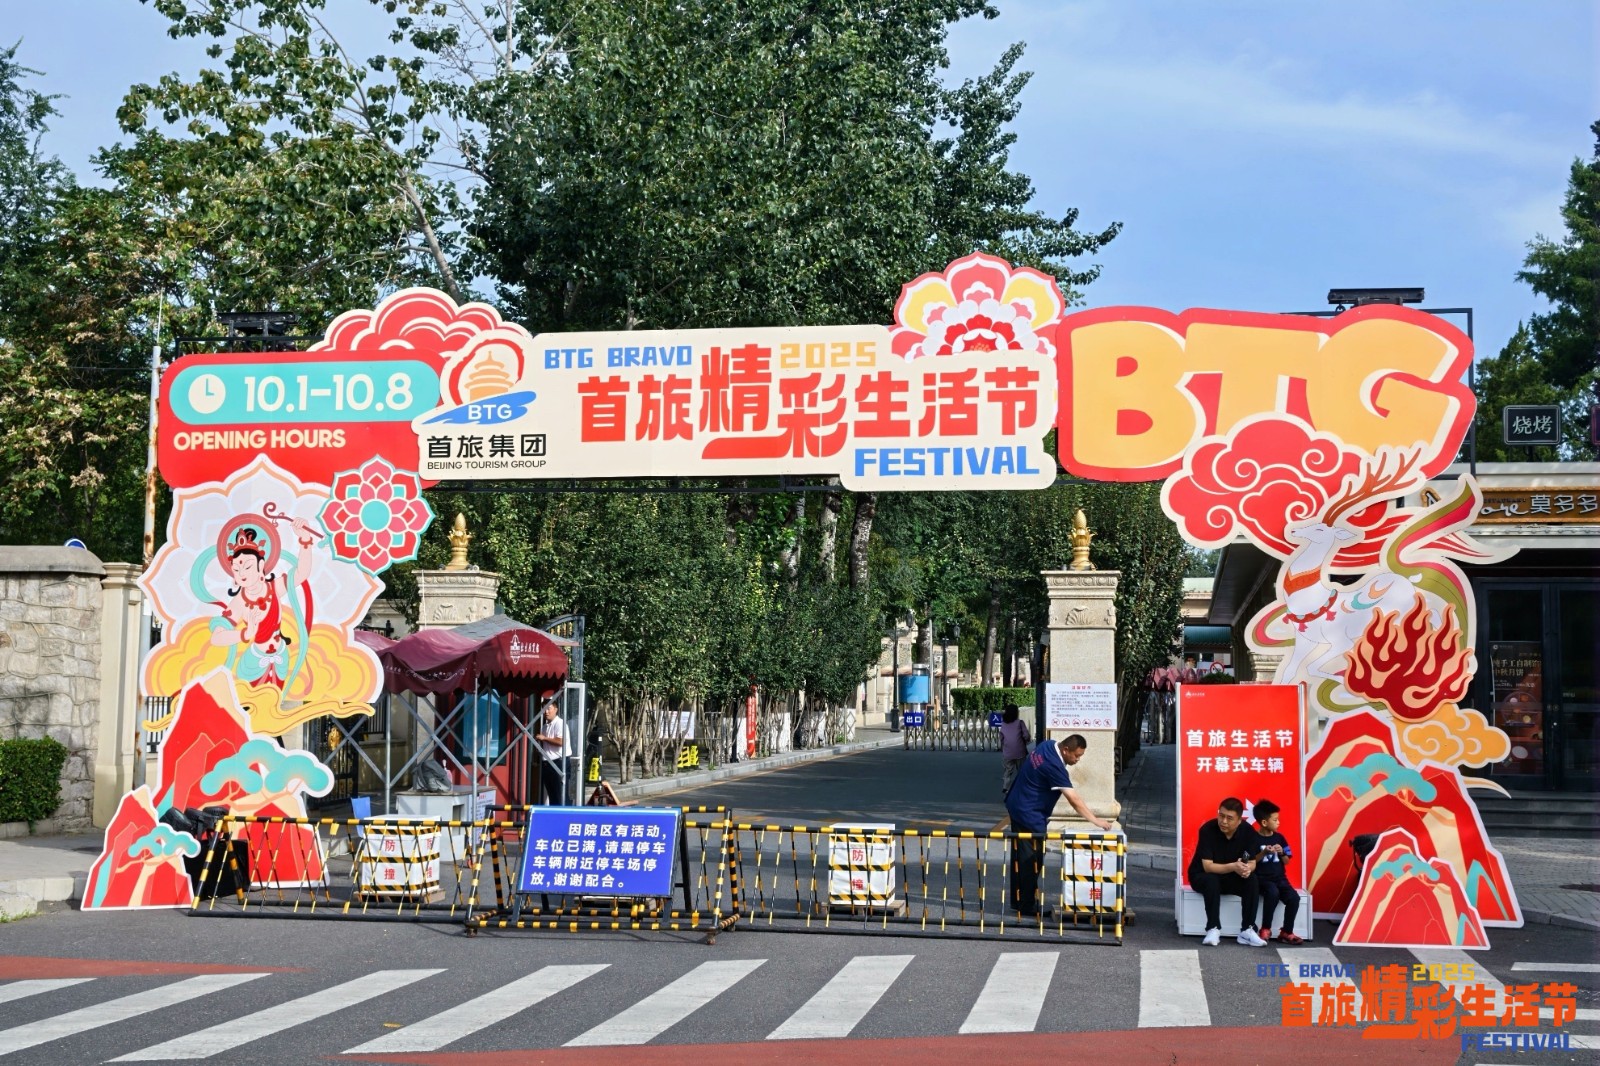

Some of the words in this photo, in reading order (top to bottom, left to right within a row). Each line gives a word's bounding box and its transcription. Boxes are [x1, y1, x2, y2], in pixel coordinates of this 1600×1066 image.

[544, 347, 593, 369] BTG
[608, 345, 692, 368] BRAVO
[779, 341, 876, 369] 2025
[578, 343, 1040, 459] 首旅精彩生活节
[467, 403, 512, 421] BTG
[1512, 415, 1553, 435] 烧烤
[173, 430, 267, 451] OPENING
[270, 428, 346, 450] HOURS
[427, 433, 547, 459] 首旅集团
[427, 461, 463, 470] BEIJING
[465, 461, 509, 470] TOURISM
[511, 460, 547, 469] GROUP
[854, 446, 1040, 477] FESTIVAL
[1530, 494, 1598, 514] 莫多多
[906, 715, 922, 723] 出口
[1186, 729, 1294, 748] 首旅生活节
[1197, 756, 1285, 774] 开幕式车辆
[532, 855, 657, 872] 车辆附近停车场停
